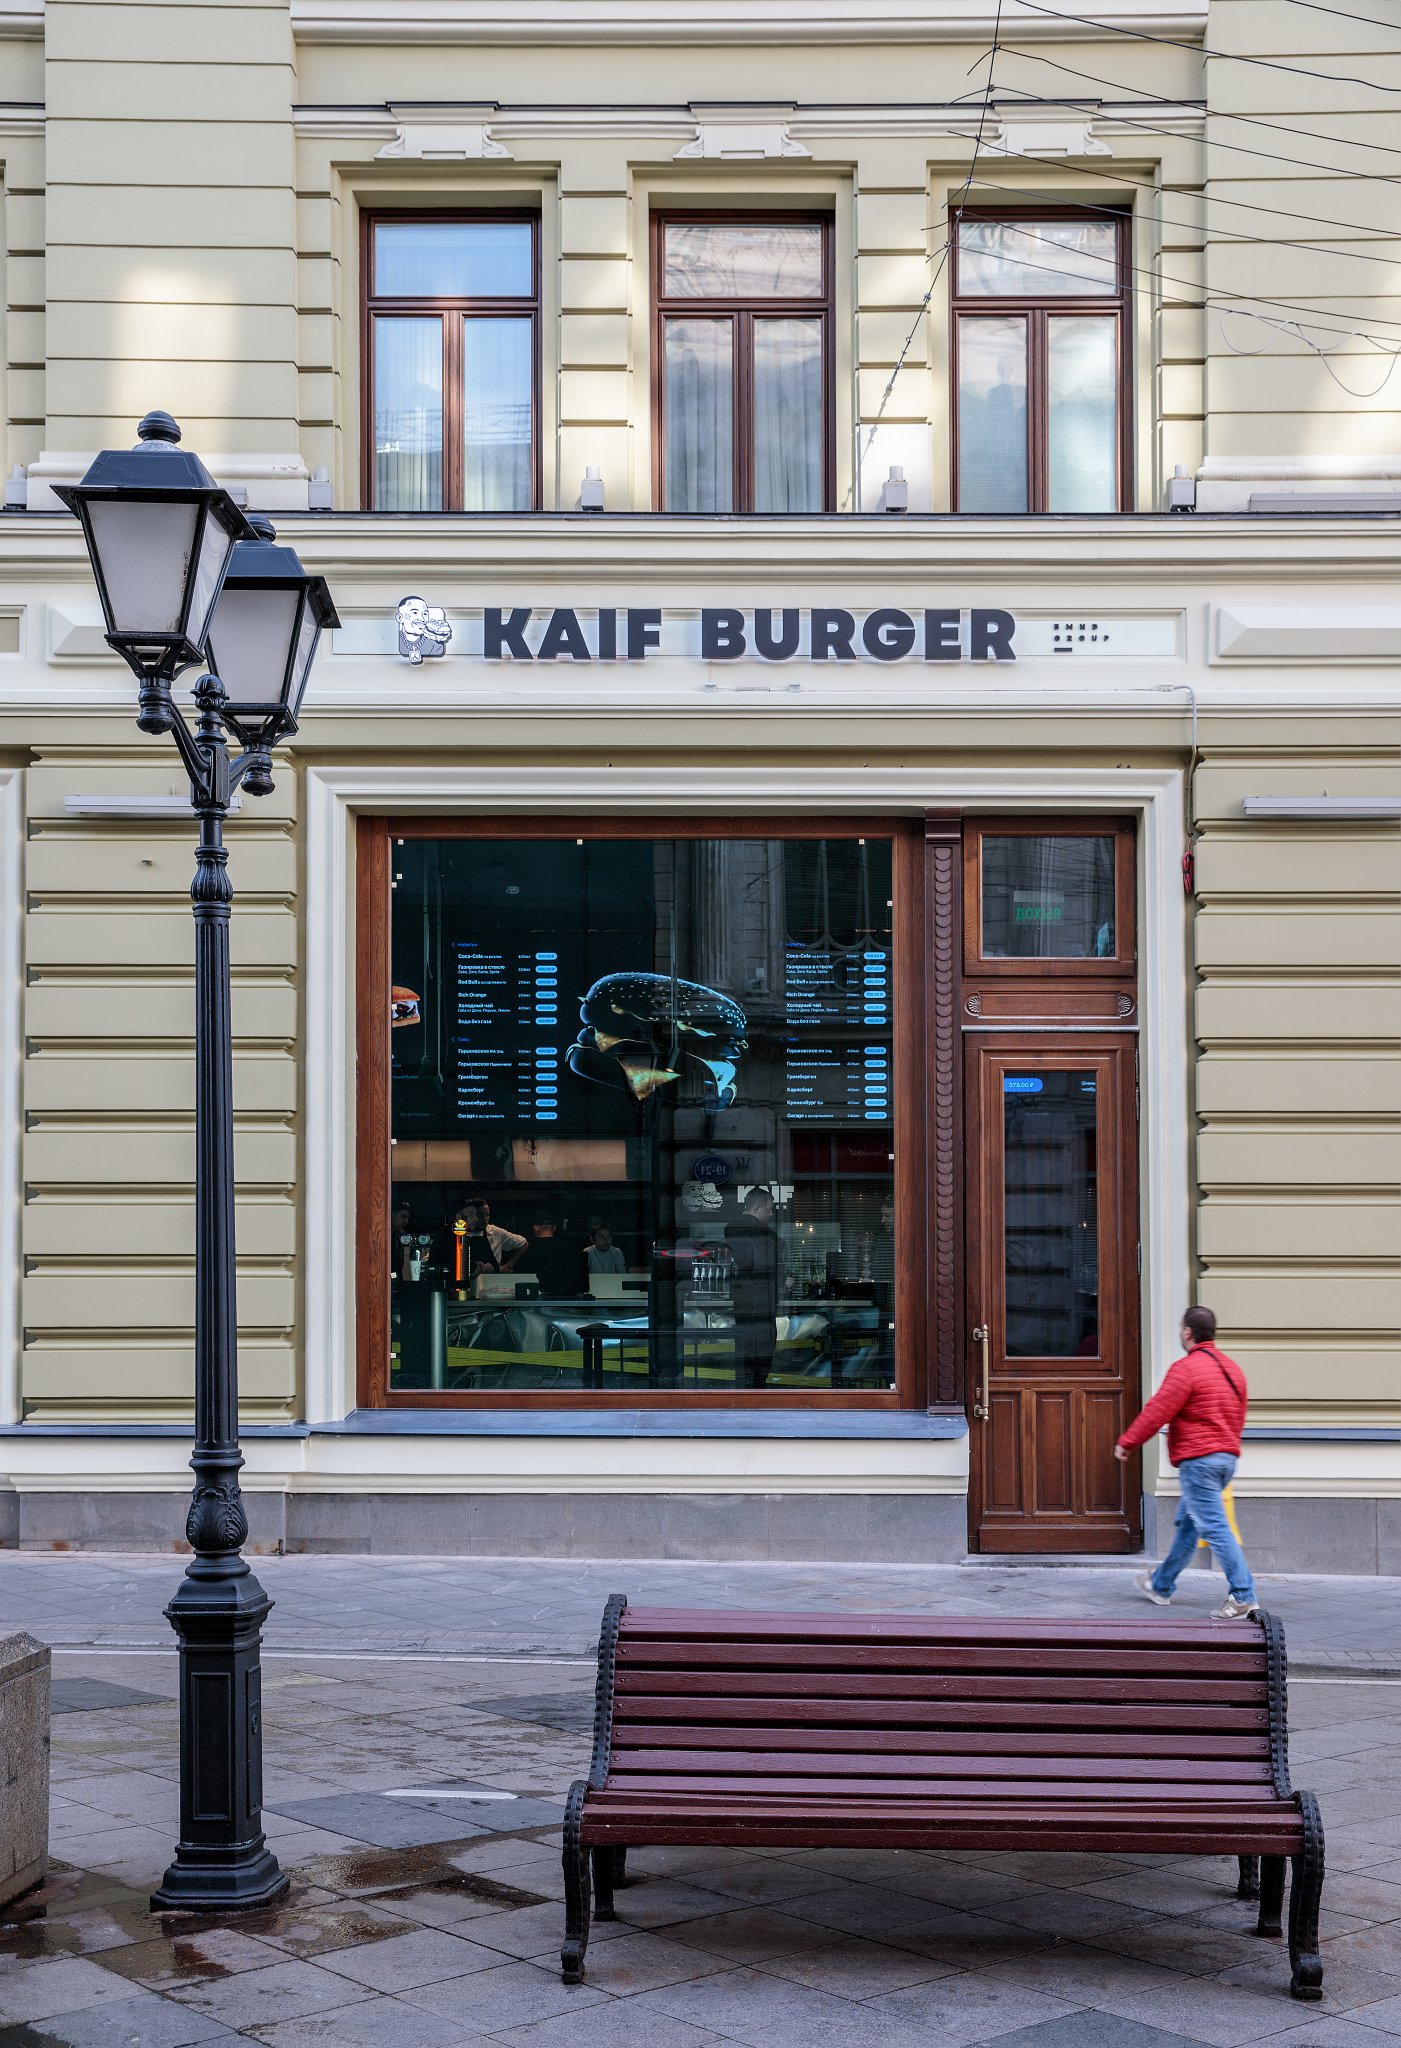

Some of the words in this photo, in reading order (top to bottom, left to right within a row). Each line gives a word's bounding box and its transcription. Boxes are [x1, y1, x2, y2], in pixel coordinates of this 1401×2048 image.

[484, 608, 661, 659] KAIF
[702, 608, 1016, 660] BURGER
[737, 1185, 794, 1203] KIF
